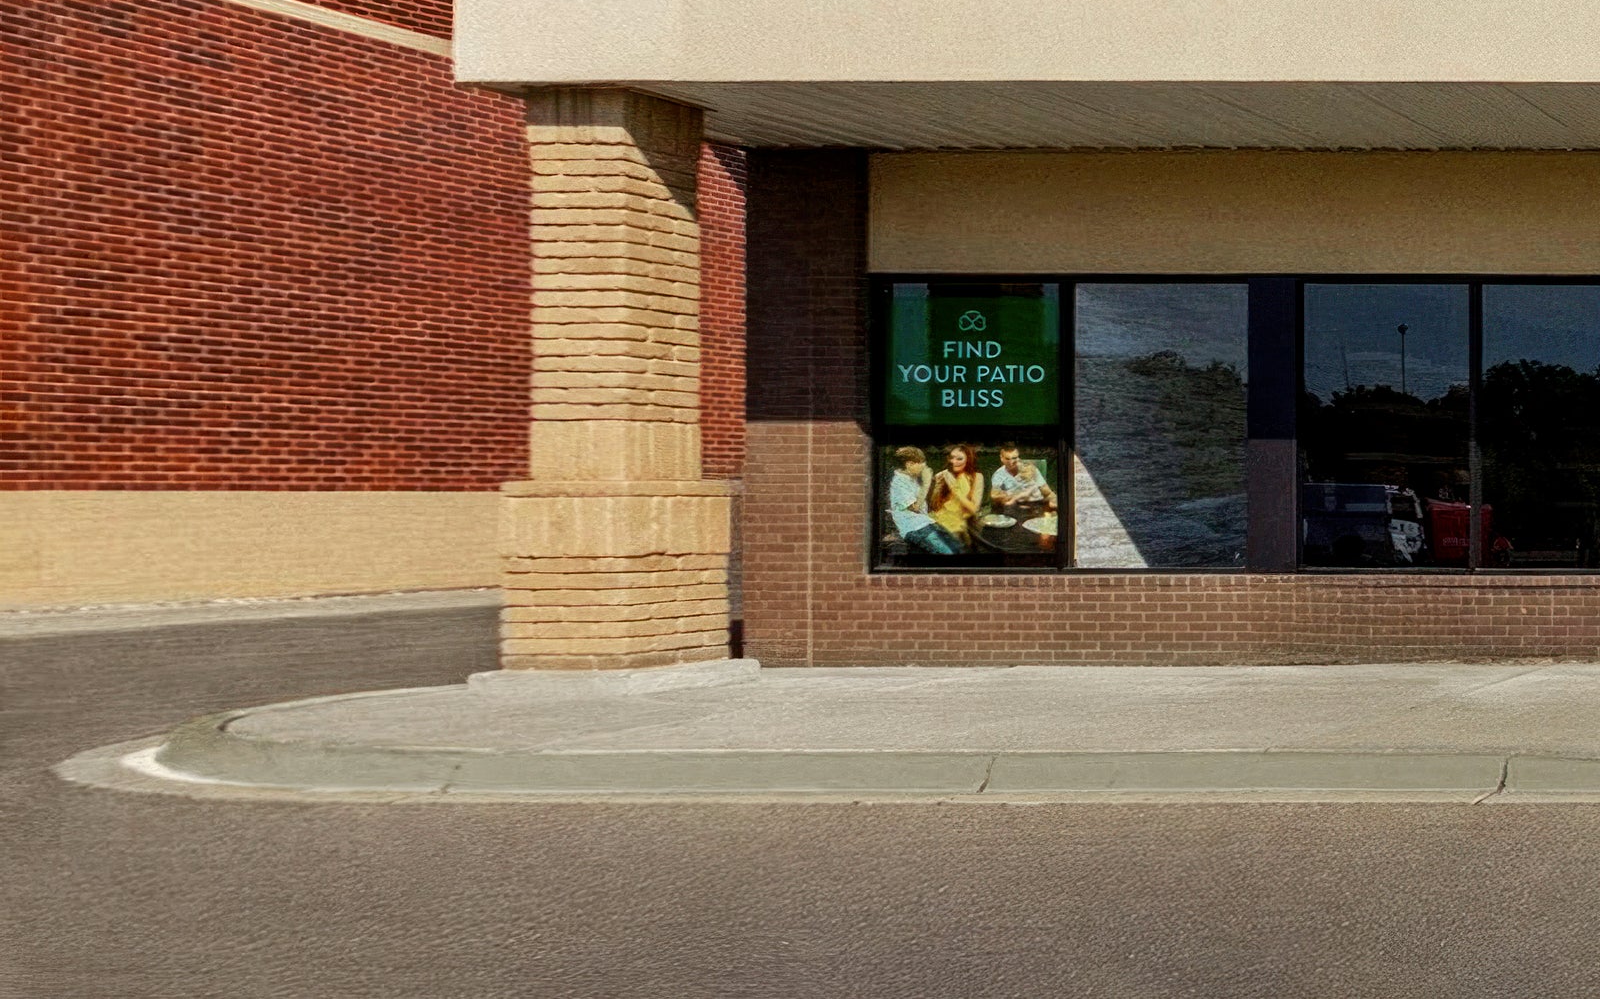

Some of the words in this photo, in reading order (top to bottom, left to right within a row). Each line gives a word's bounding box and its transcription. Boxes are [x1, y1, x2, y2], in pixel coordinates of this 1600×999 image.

[943, 340, 1002, 359] FIND
[897, 364, 967, 383] YOUR
[976, 364, 1046, 383] PATIO
[941, 388, 1005, 408] BLISS
